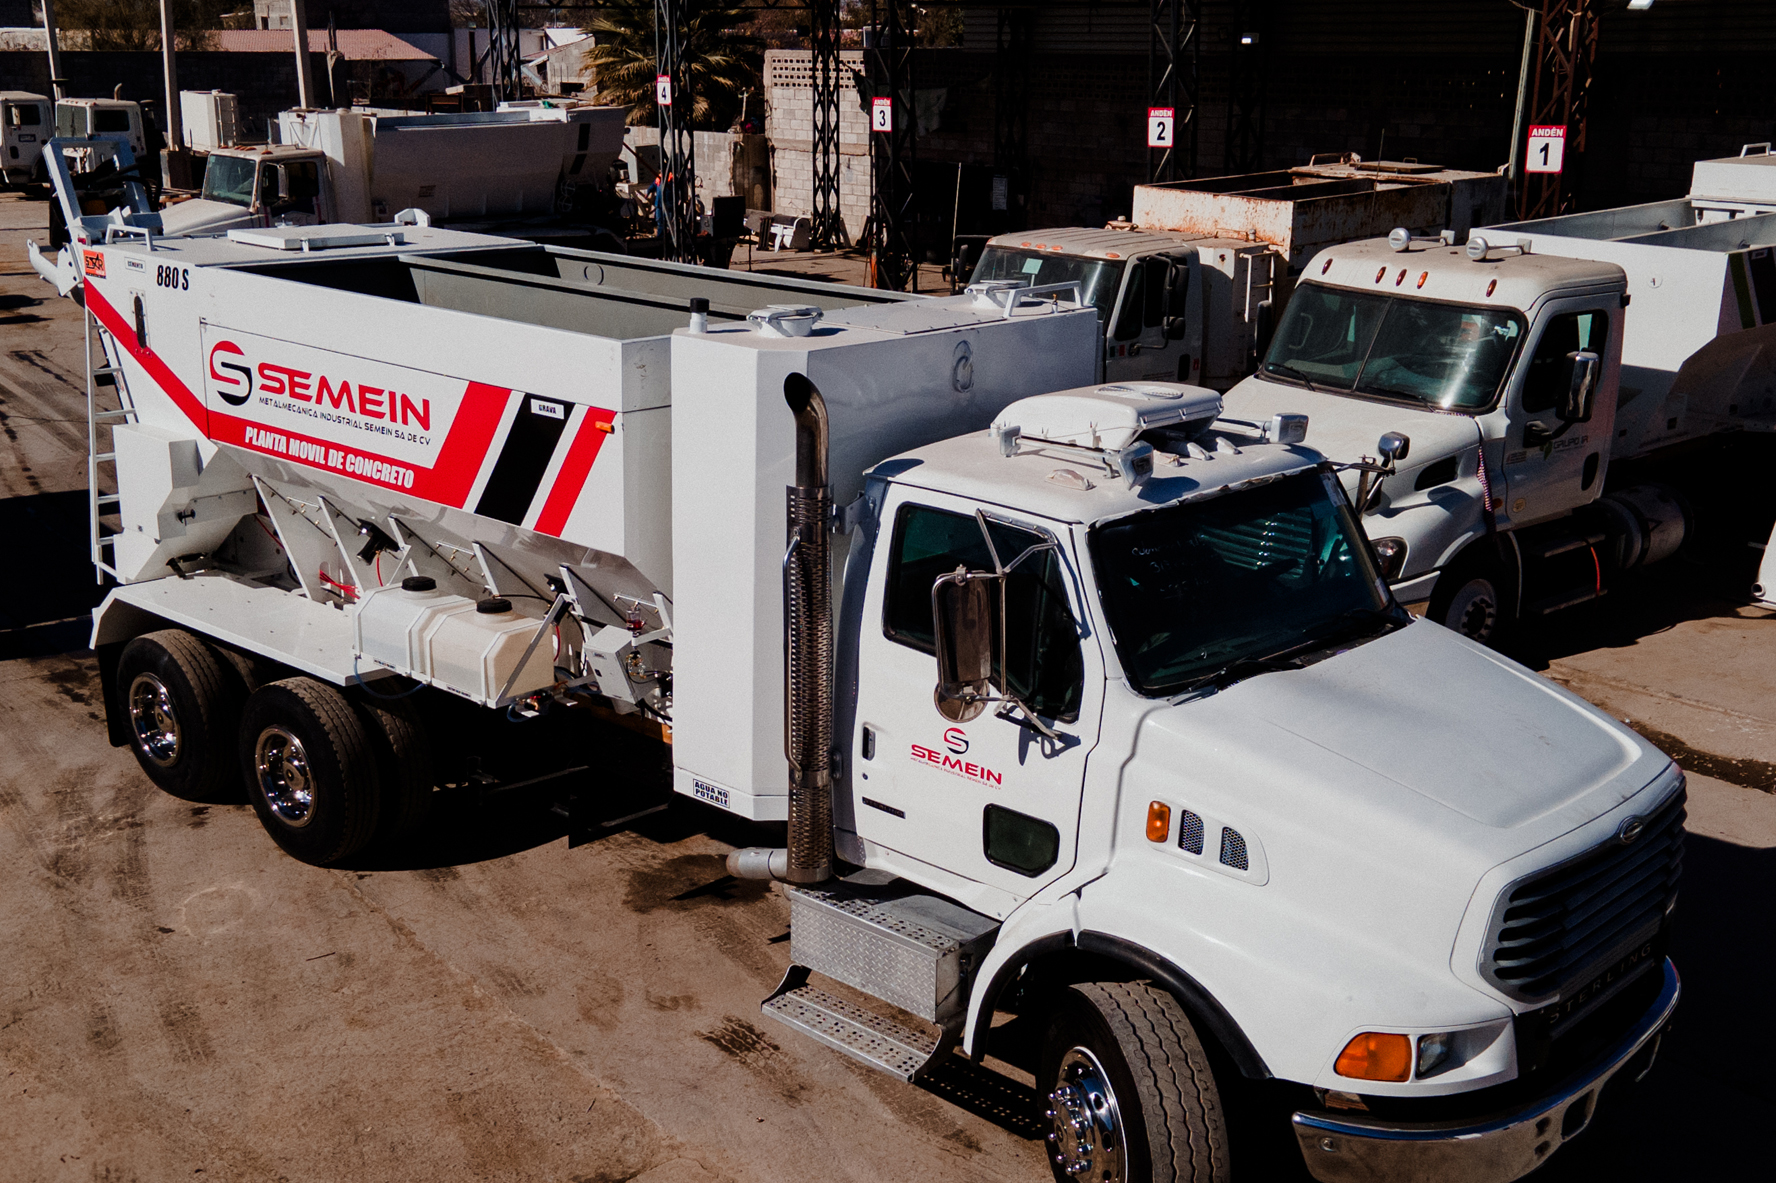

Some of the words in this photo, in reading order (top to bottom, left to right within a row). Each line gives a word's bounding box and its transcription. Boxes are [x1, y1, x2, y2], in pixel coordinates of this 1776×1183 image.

[661, 86, 667, 101] 4
[879, 109, 886, 127] 3
[1156, 121, 1166, 141] 2
[1531, 127, 1564, 136] ANDÉN
[1539, 142, 1550, 166] 1
[156, 264, 179, 289] 880
[181, 268, 189, 291] S
[257, 362, 431, 431] SEMEIN
[258, 396, 319, 419] METALMECANICA
[319, 412, 363, 430] INDUSTRIAL
[364, 422, 393, 436] SEMEIN
[394, 429, 406, 440] SA
[407, 433, 417, 443] DE
[419, 436, 431, 446] CV
[244, 426, 287, 454] PLANTA
[287, 438, 326, 465] MOVIL
[327, 448, 345, 470] DE
[345, 452, 415, 489] CONCRETO
[910, 744, 1002, 785] SEMEIN
[694, 781, 716, 794] AGUA
[717, 789, 728, 799] NO
[695, 788, 728, 805] POTABLE
[1549, 942, 1652, 1024] STERLING
